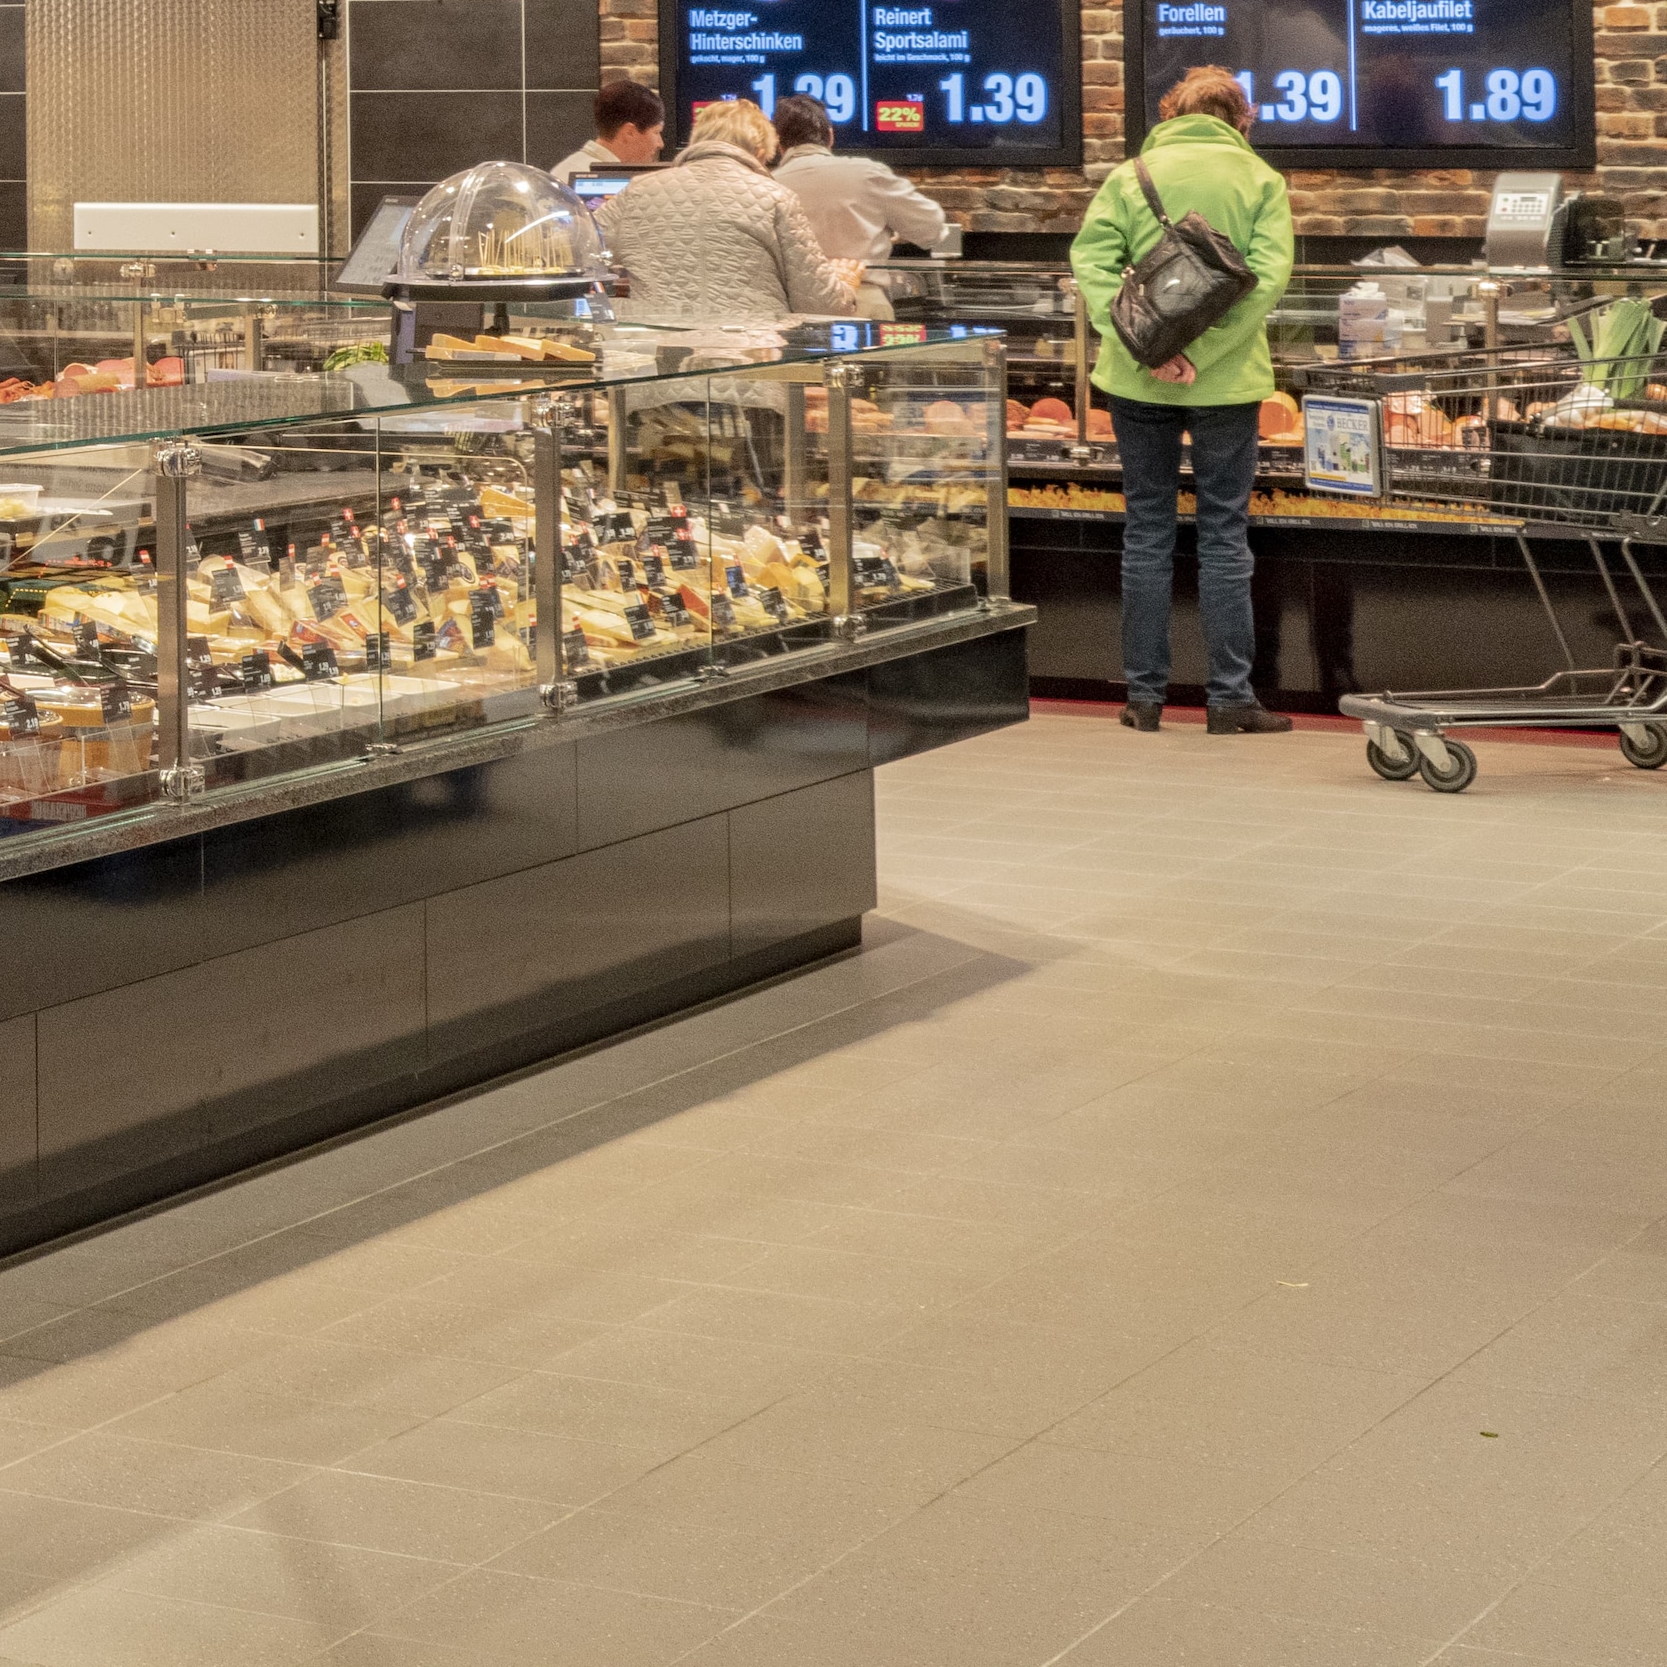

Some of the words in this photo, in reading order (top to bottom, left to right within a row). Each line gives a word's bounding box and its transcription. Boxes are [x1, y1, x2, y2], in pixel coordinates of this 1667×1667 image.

[690, 9, 759, 30] Metzger-
[874, 7, 932, 26] Reinert
[1157, 3, 1226, 24] Forellen
[1364, 0, 1474, 24] Kabeljaufilet
[690, 32, 803, 51] Hinterschinken
[874, 30, 969, 53] Sportsalami
[939, 72, 1049, 124] 1.39
[1435, 67, 1558, 123] 1.89
[878, 107, 922, 123] 22%
[1336, 418, 1369, 431] BECKER
